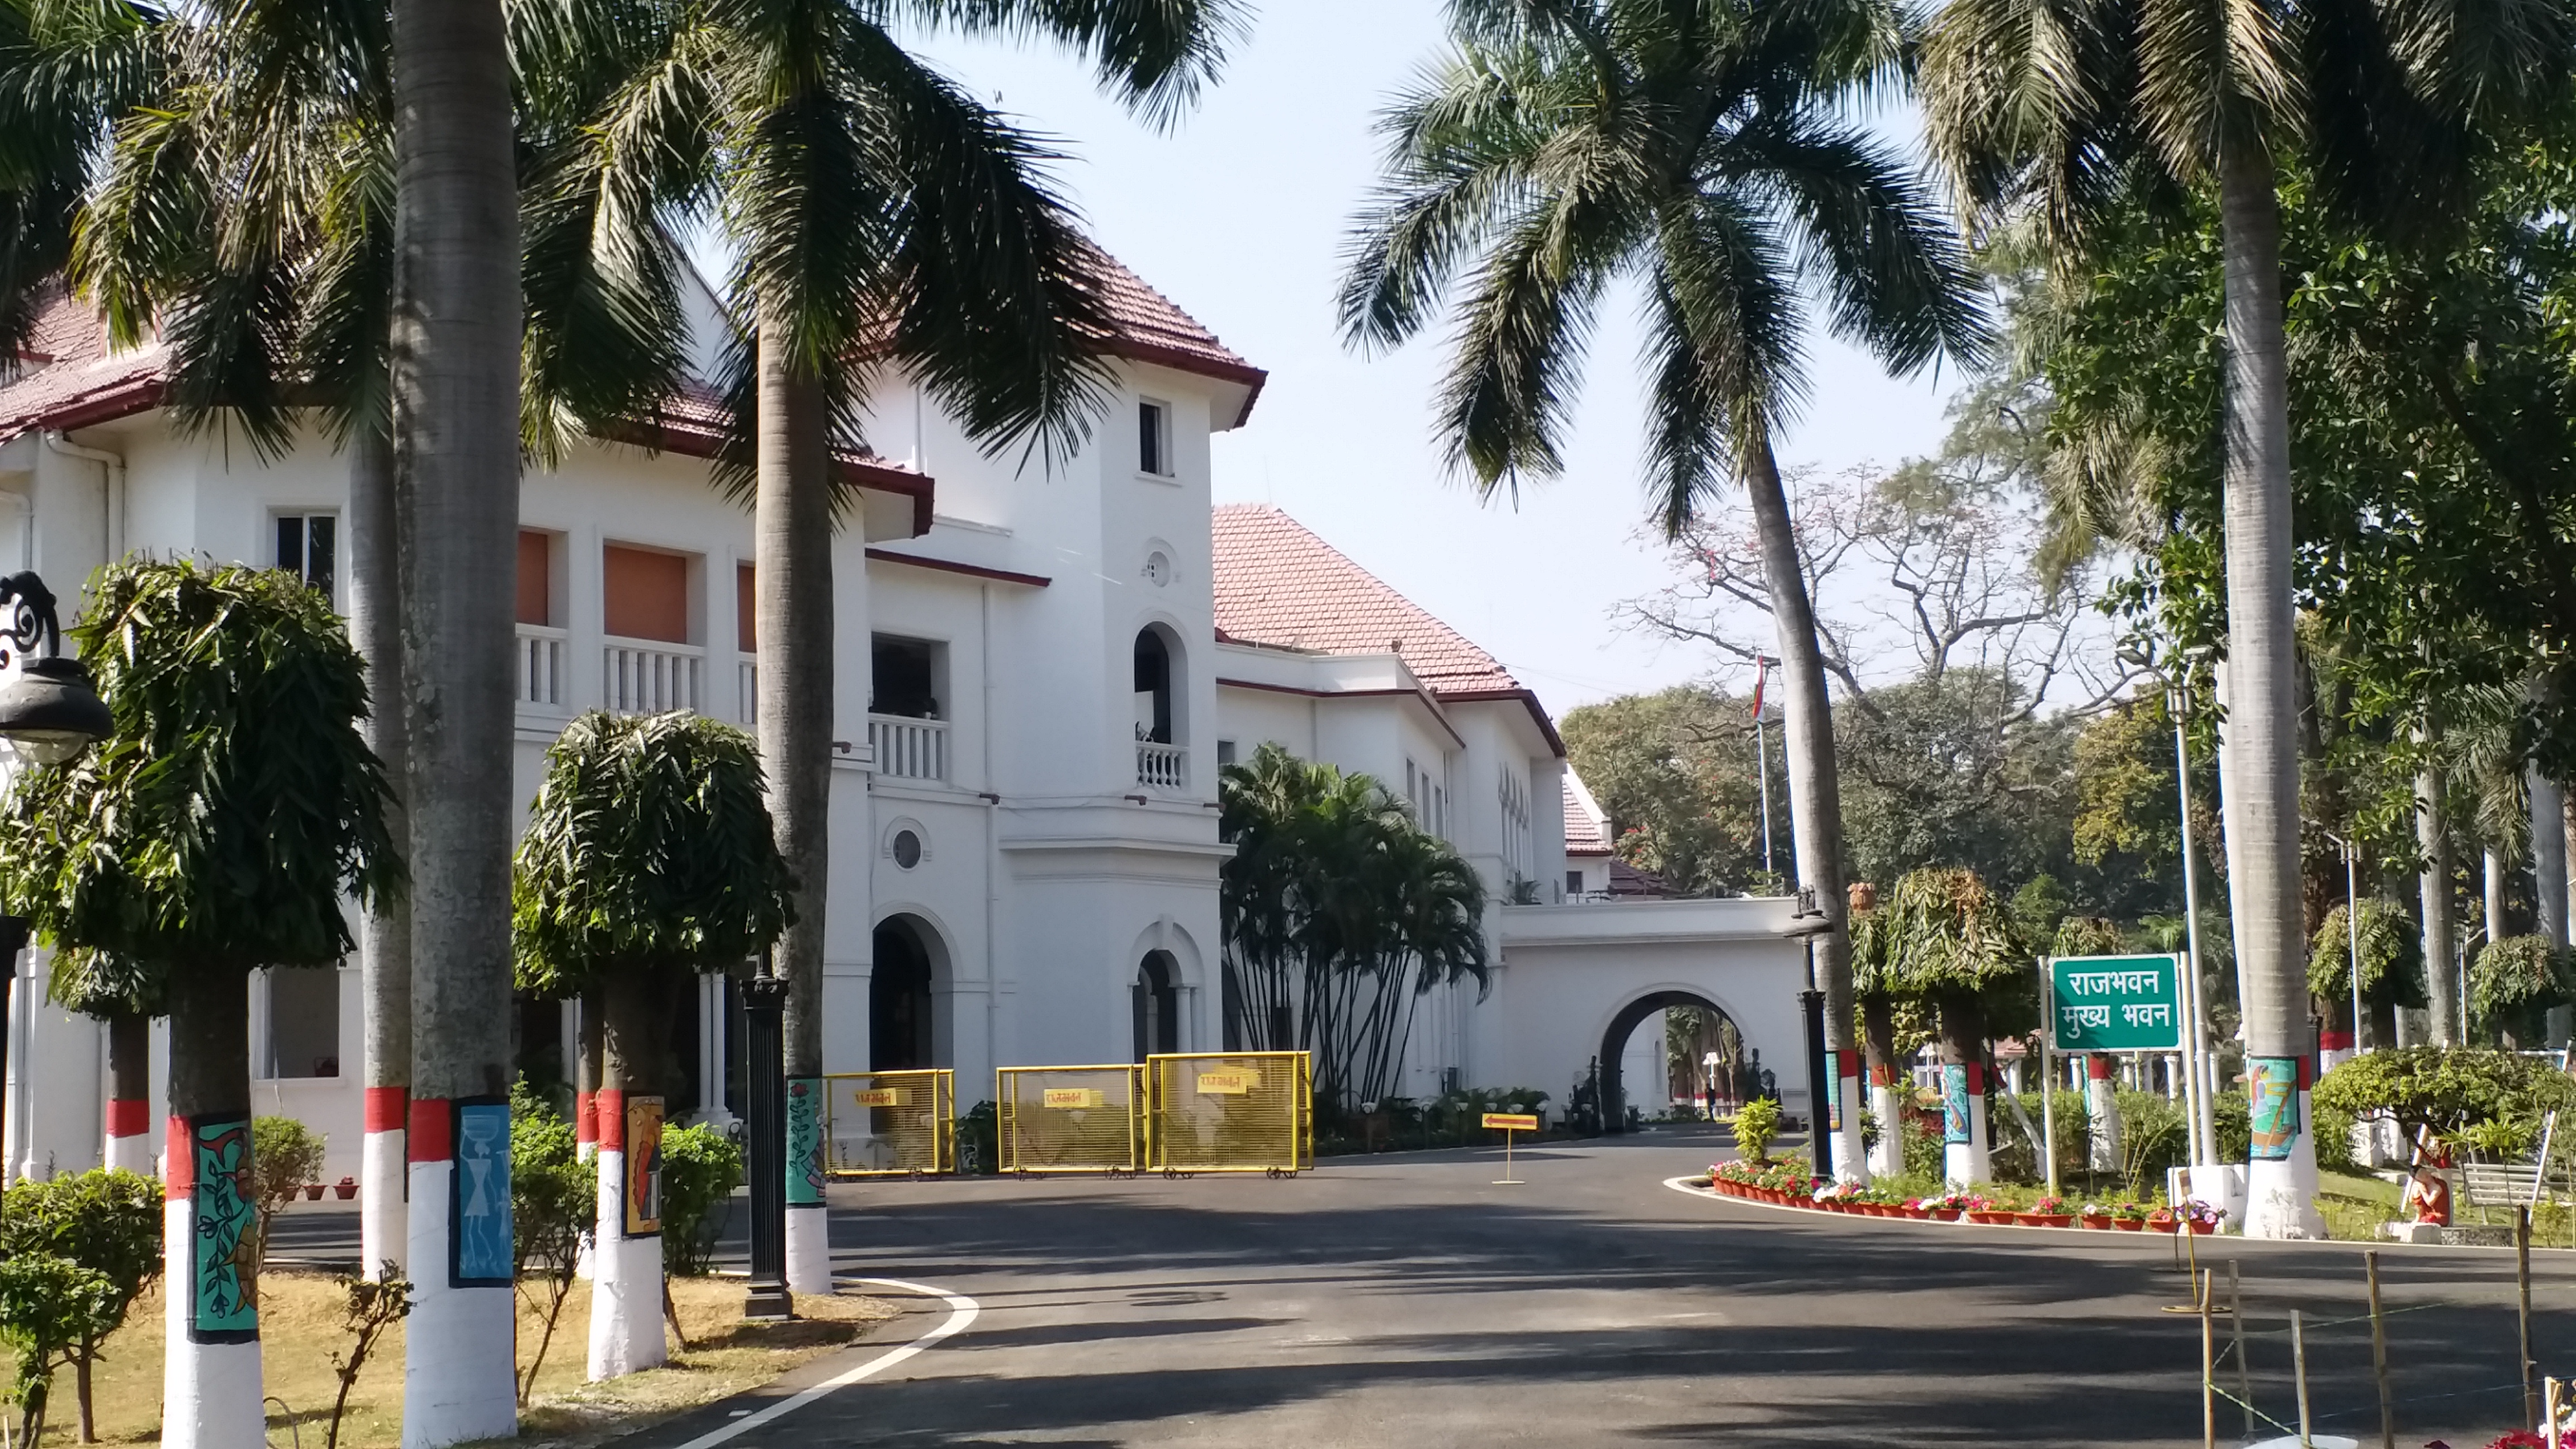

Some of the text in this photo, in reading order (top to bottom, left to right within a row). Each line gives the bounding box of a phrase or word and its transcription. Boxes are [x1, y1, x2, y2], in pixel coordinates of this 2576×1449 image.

[2067, 970, 2160, 996] राजभवन
[2061, 1003, 2171, 1040] मुख्य भवन
